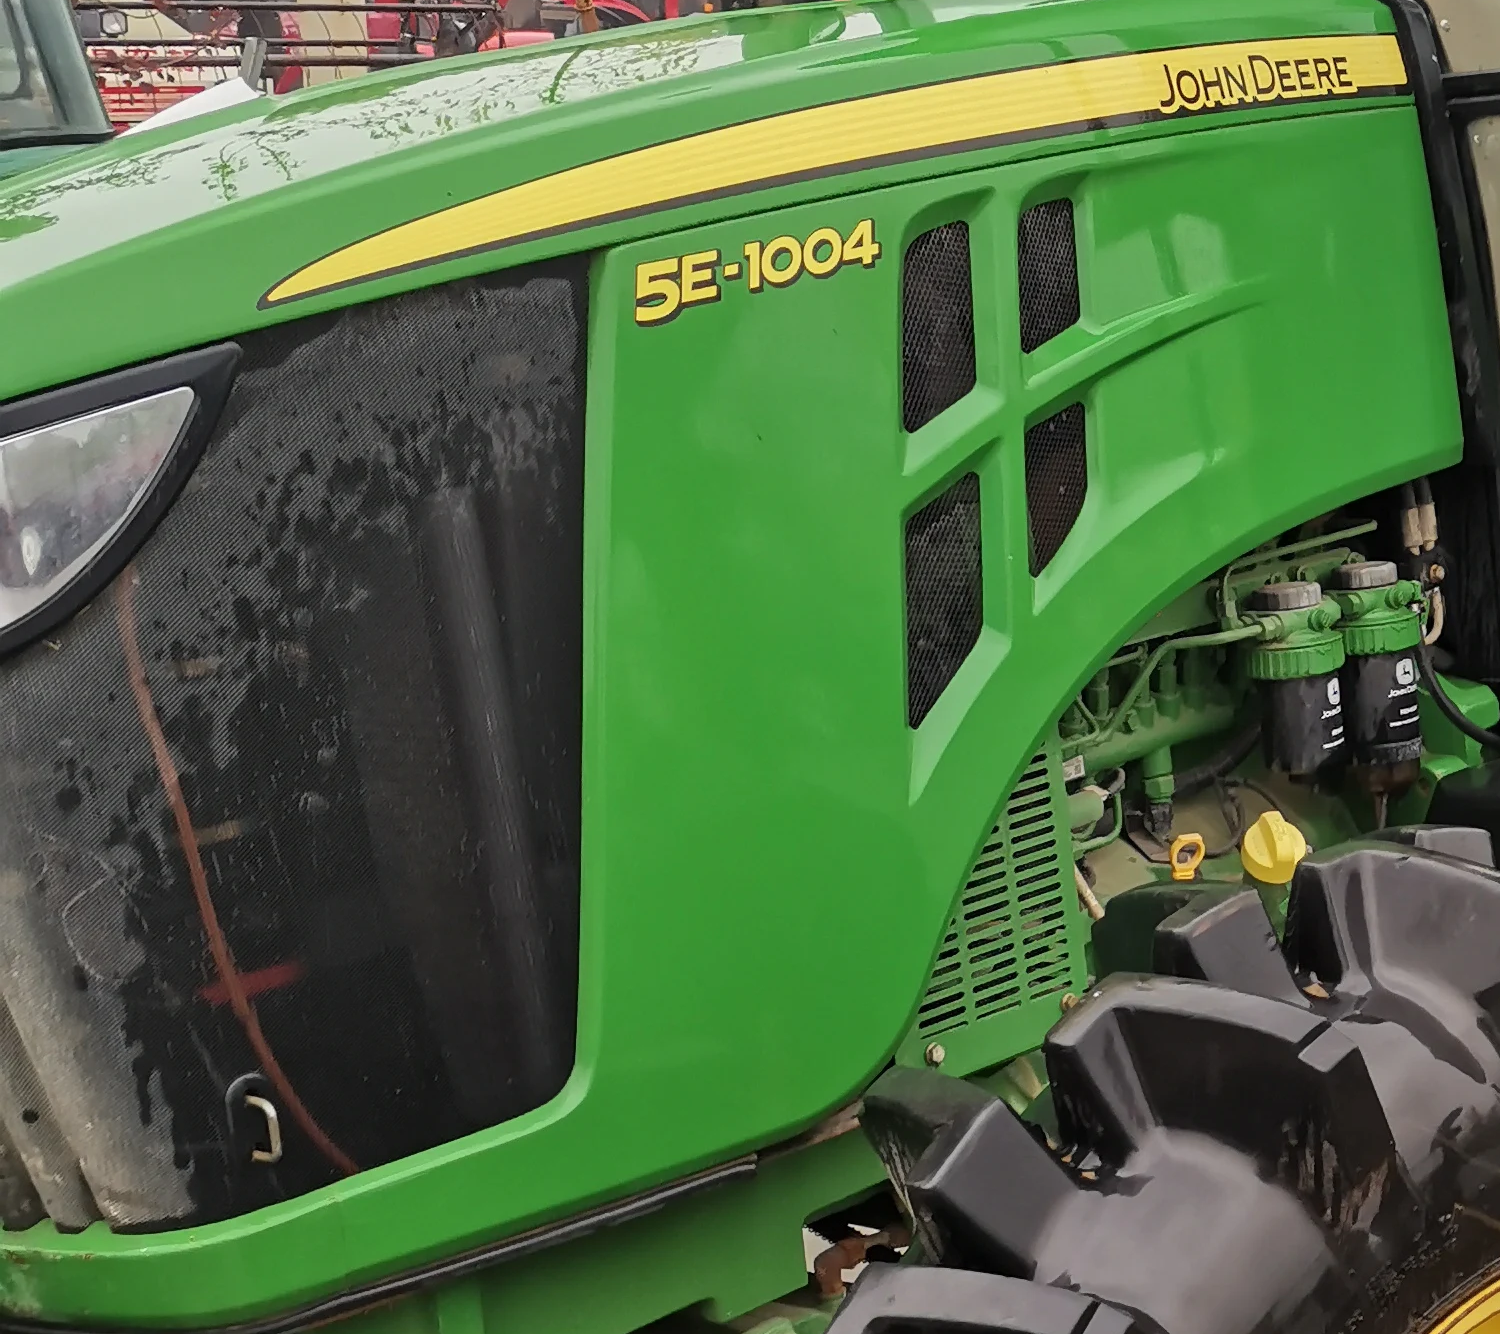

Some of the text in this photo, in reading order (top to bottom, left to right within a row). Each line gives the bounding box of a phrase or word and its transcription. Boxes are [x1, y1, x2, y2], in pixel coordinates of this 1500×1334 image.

[1160, 54, 1354, 108] JOHN DEERE
[634, 217, 882, 327] 5E-1004
